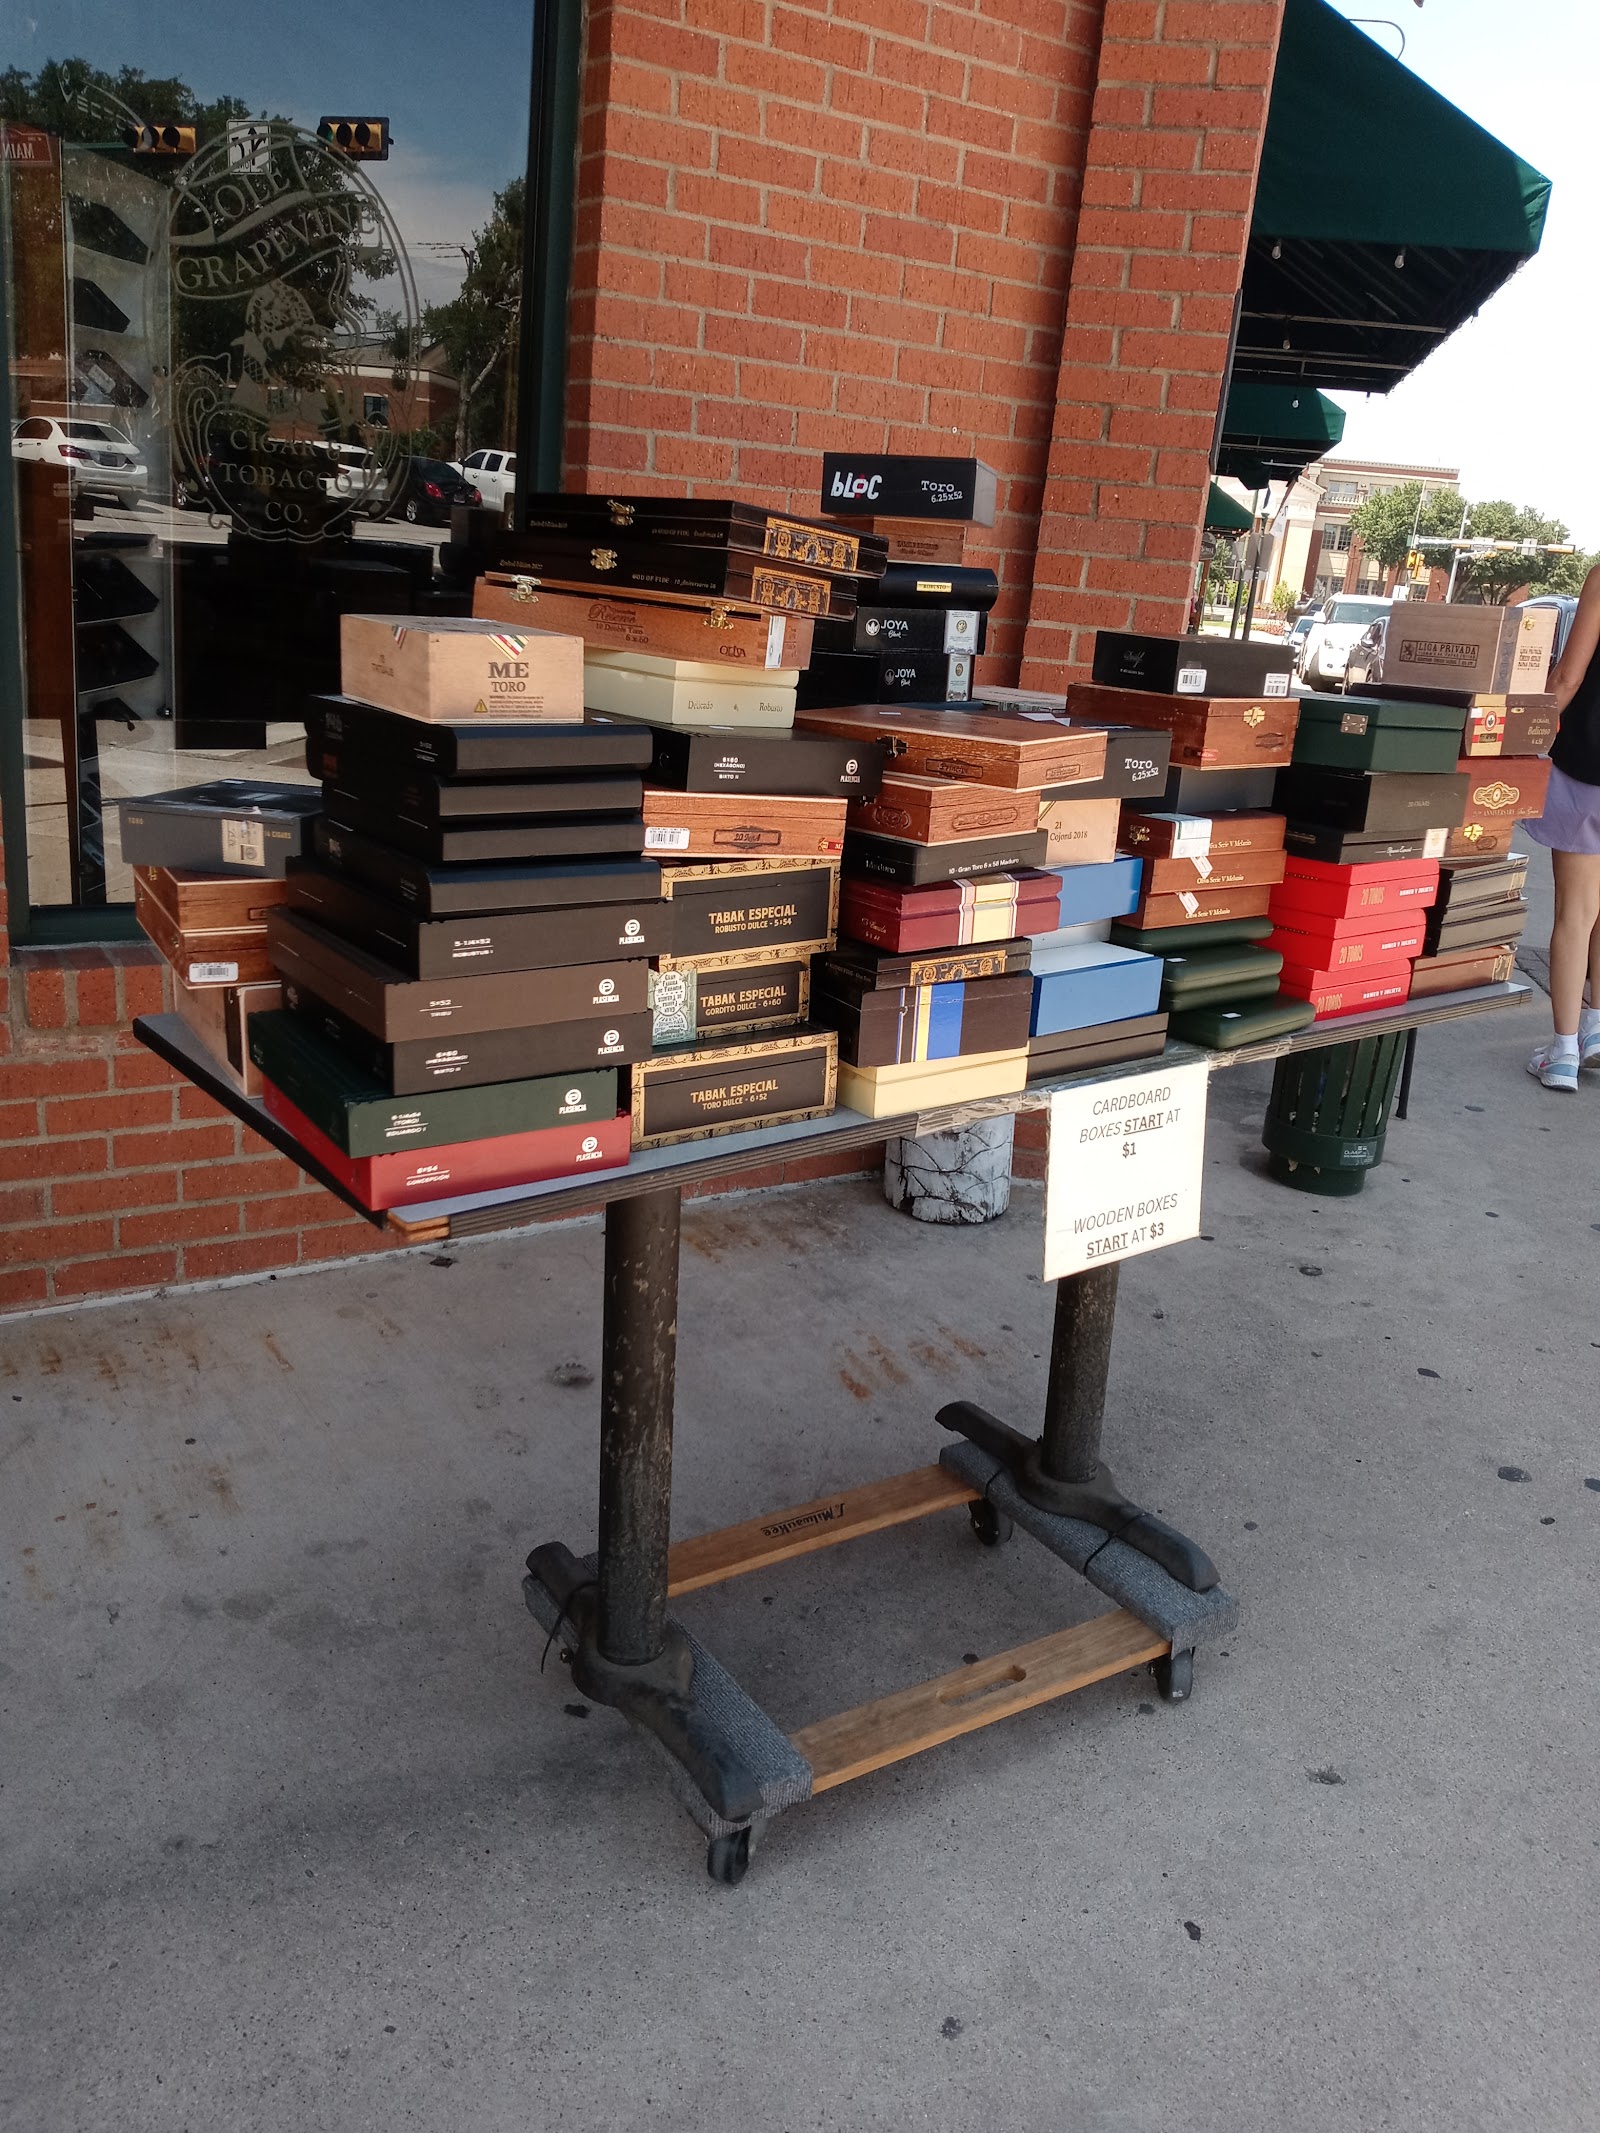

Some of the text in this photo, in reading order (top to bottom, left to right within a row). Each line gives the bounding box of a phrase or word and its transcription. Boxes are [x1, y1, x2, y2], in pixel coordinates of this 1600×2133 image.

[175, 202, 376, 289] GRAPEVINE
[230, 430, 317, 457] CIGAR
[219, 463, 353, 493] TOBACCO
[921, 480, 954, 493] Toro
[931, 491, 963, 503] 6.25x52
[881, 619, 909, 631] JOYA
[1418, 642, 1437, 652] LIGA
[1439, 644, 1476, 655] PRIVADA
[488, 661, 530, 679] ME
[894, 668, 916, 678] JOYA
[491, 681, 526, 693] TORO
[759, 702, 783, 713] Robusto
[1124, 758, 1153, 769] Toro
[1131, 767, 1159, 782] 6.25x52
[1055, 821, 1062, 829] 21
[958, 866, 972, 874] Gran
[1000, 857, 1020, 866] Maduro
[708, 904, 797, 925] TABAK ESPECIAL
[714, 922, 747, 934] ROBUSTO
[747, 920, 768, 930] DULCE
[619, 935, 645, 945] PLASENCIA
[593, 994, 620, 1005] PLASENCIA
[700, 993, 736, 1008] TABAK
[739, 985, 787, 1003] ESPECIAL
[705, 1005, 736, 1017] GORDITO
[736, 1002, 757, 1012] DULCE
[598, 1044, 624, 1055] PLASENCIA
[690, 1079, 778, 1104] TABAK ESPECIAL
[702, 1100, 721, 1111] TORO
[722, 1097, 743, 1107] DULCE
[1092, 1086, 1171, 1116] CARDBOARD
[559, 1103, 587, 1115] PLASENCIA
[1079, 1108, 1181, 1143] BOXES START AT
[576, 1151, 603, 1163] PLASENCIA
[1122, 1142, 1137, 1159] $1
[1073, 1193, 1178, 1234] WOODEN BOXES
[1086, 1222, 1165, 1257] START AT $3
